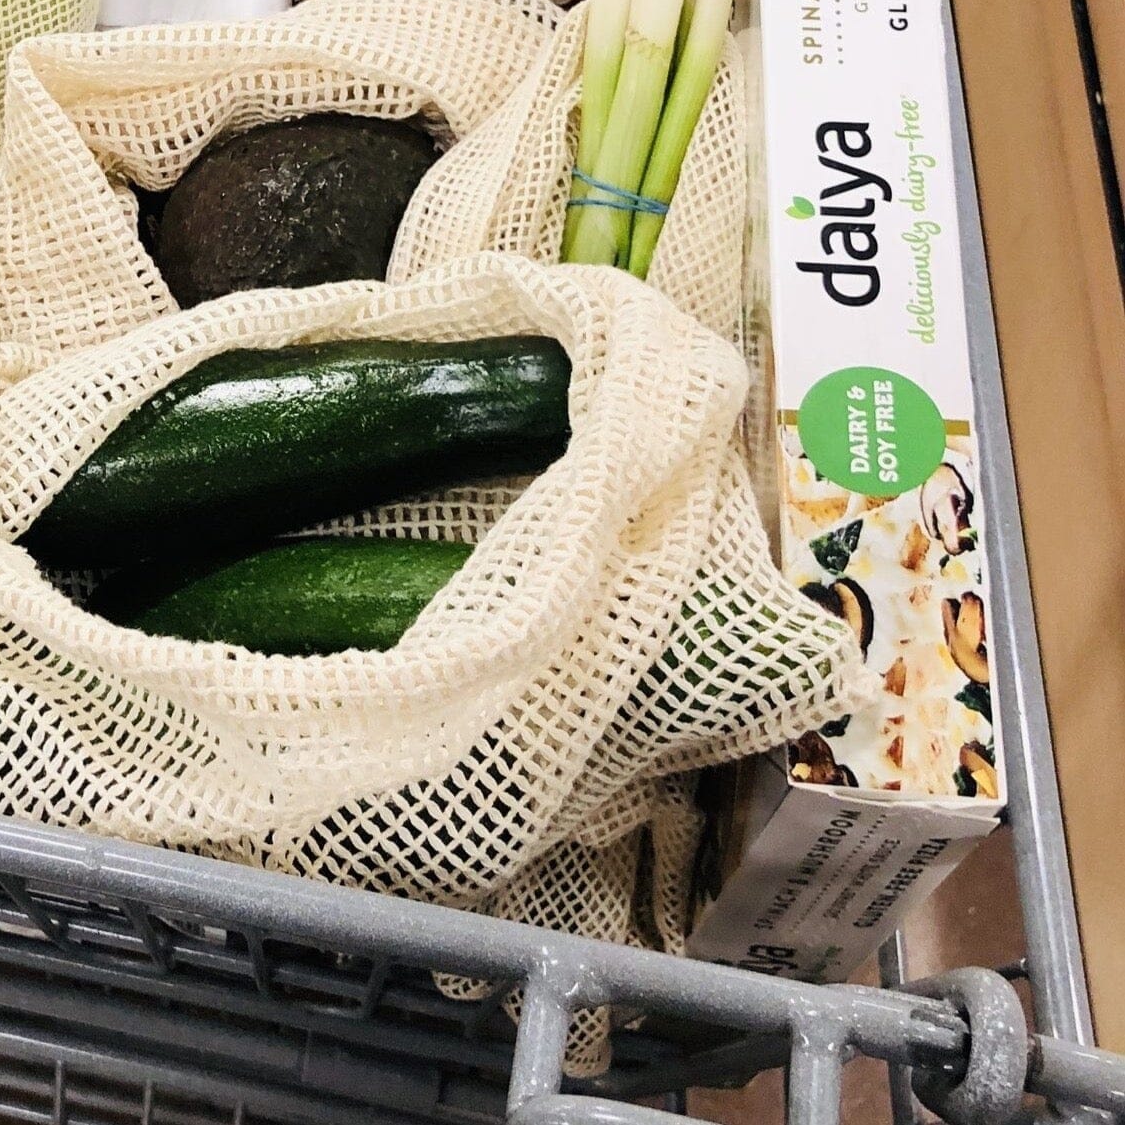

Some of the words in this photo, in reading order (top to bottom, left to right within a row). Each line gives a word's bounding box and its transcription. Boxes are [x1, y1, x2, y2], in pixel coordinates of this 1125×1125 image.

[894, 98, 936, 212] dairy-free
[790, 119, 893, 308] daiya
[901, 220, 942, 345] deliciously
[846, 385, 866, 401] &
[873, 380, 895, 432] FREE
[847, 404, 870, 473] DAIRY
[877, 437, 899, 483] SOY
